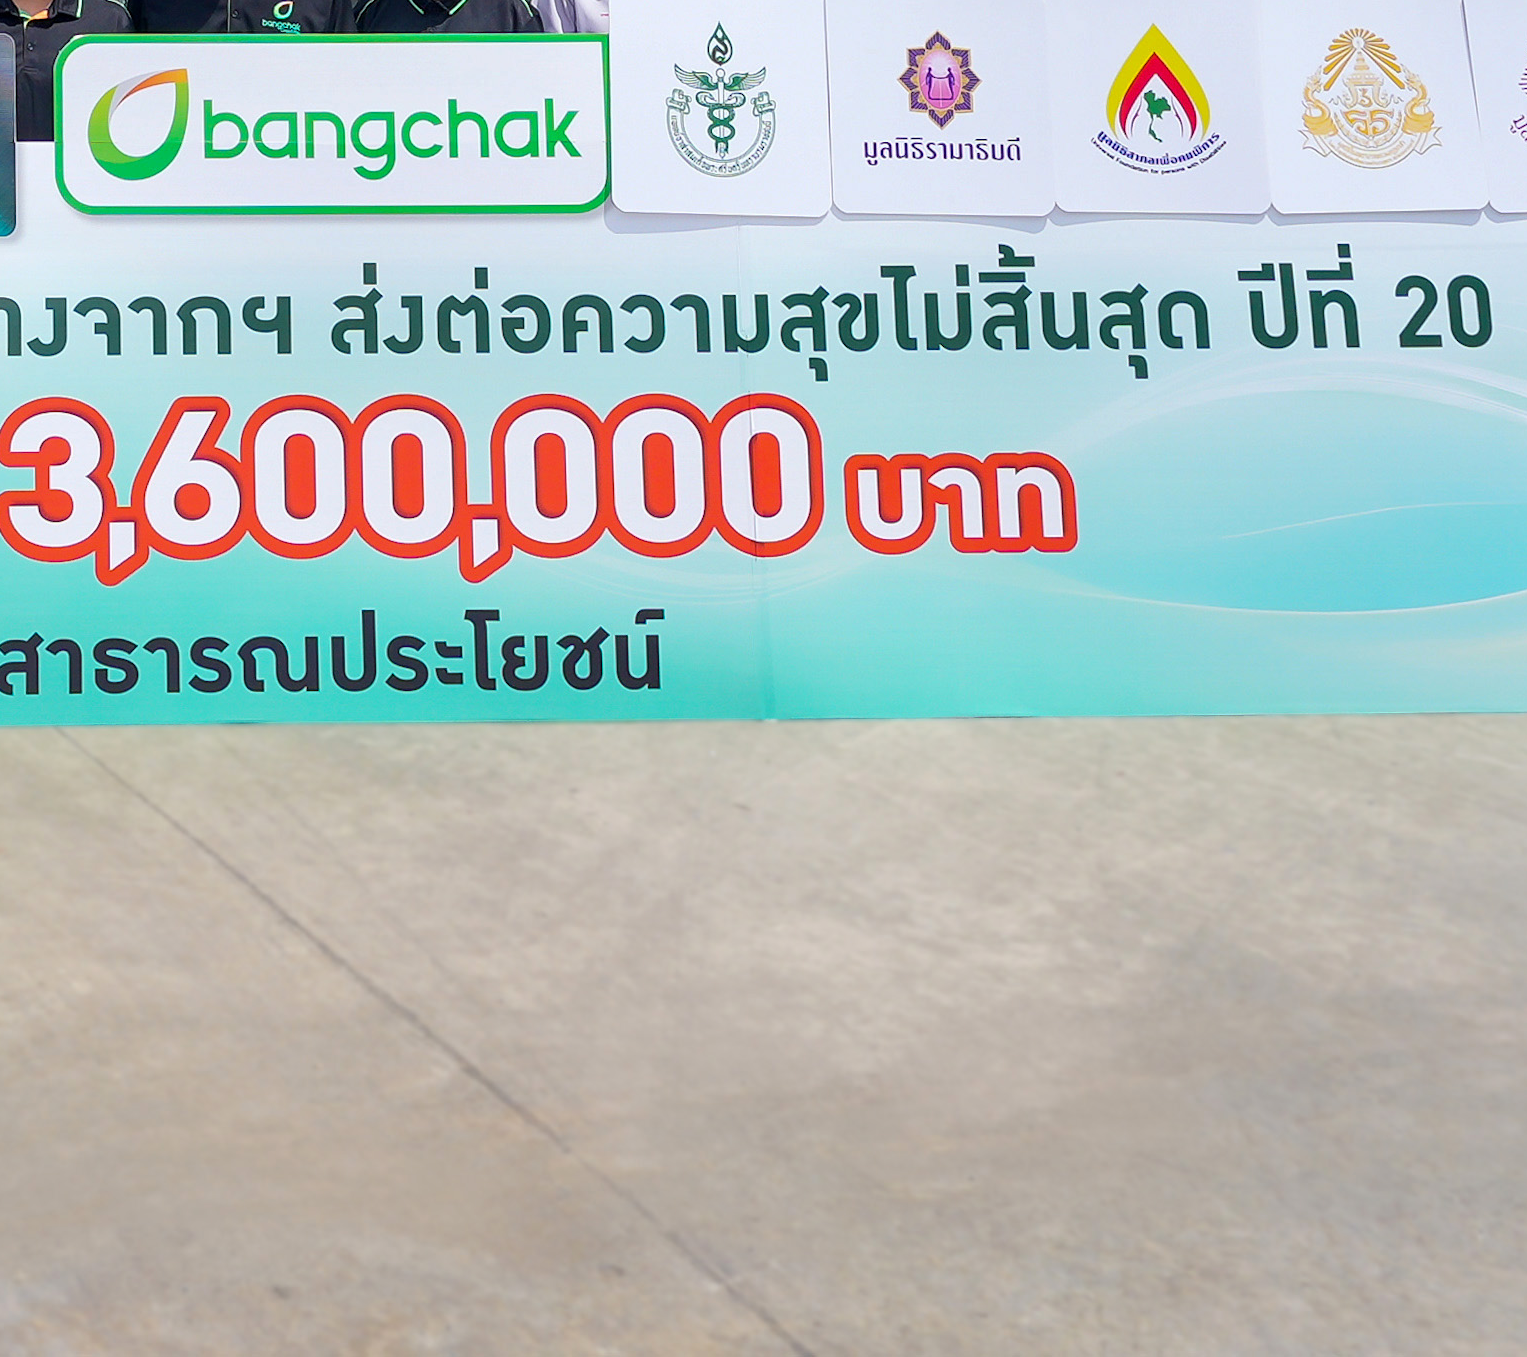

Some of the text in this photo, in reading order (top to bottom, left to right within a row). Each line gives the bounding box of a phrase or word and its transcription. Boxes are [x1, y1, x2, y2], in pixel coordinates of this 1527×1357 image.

[261, 18, 301, 32] bangchak
[203, 97, 583, 181] bangchak
[863, 137, 1022, 166] มูลนิธิรามาธิบดี
[330, 254, 1211, 381] ส่งต่อความสุขไม่สิ้นสุด
[1248, 262, 1363, 351] ปีที่
[1395, 274, 1493, 348] 20
[846, 446, 1075, 555] บาท
